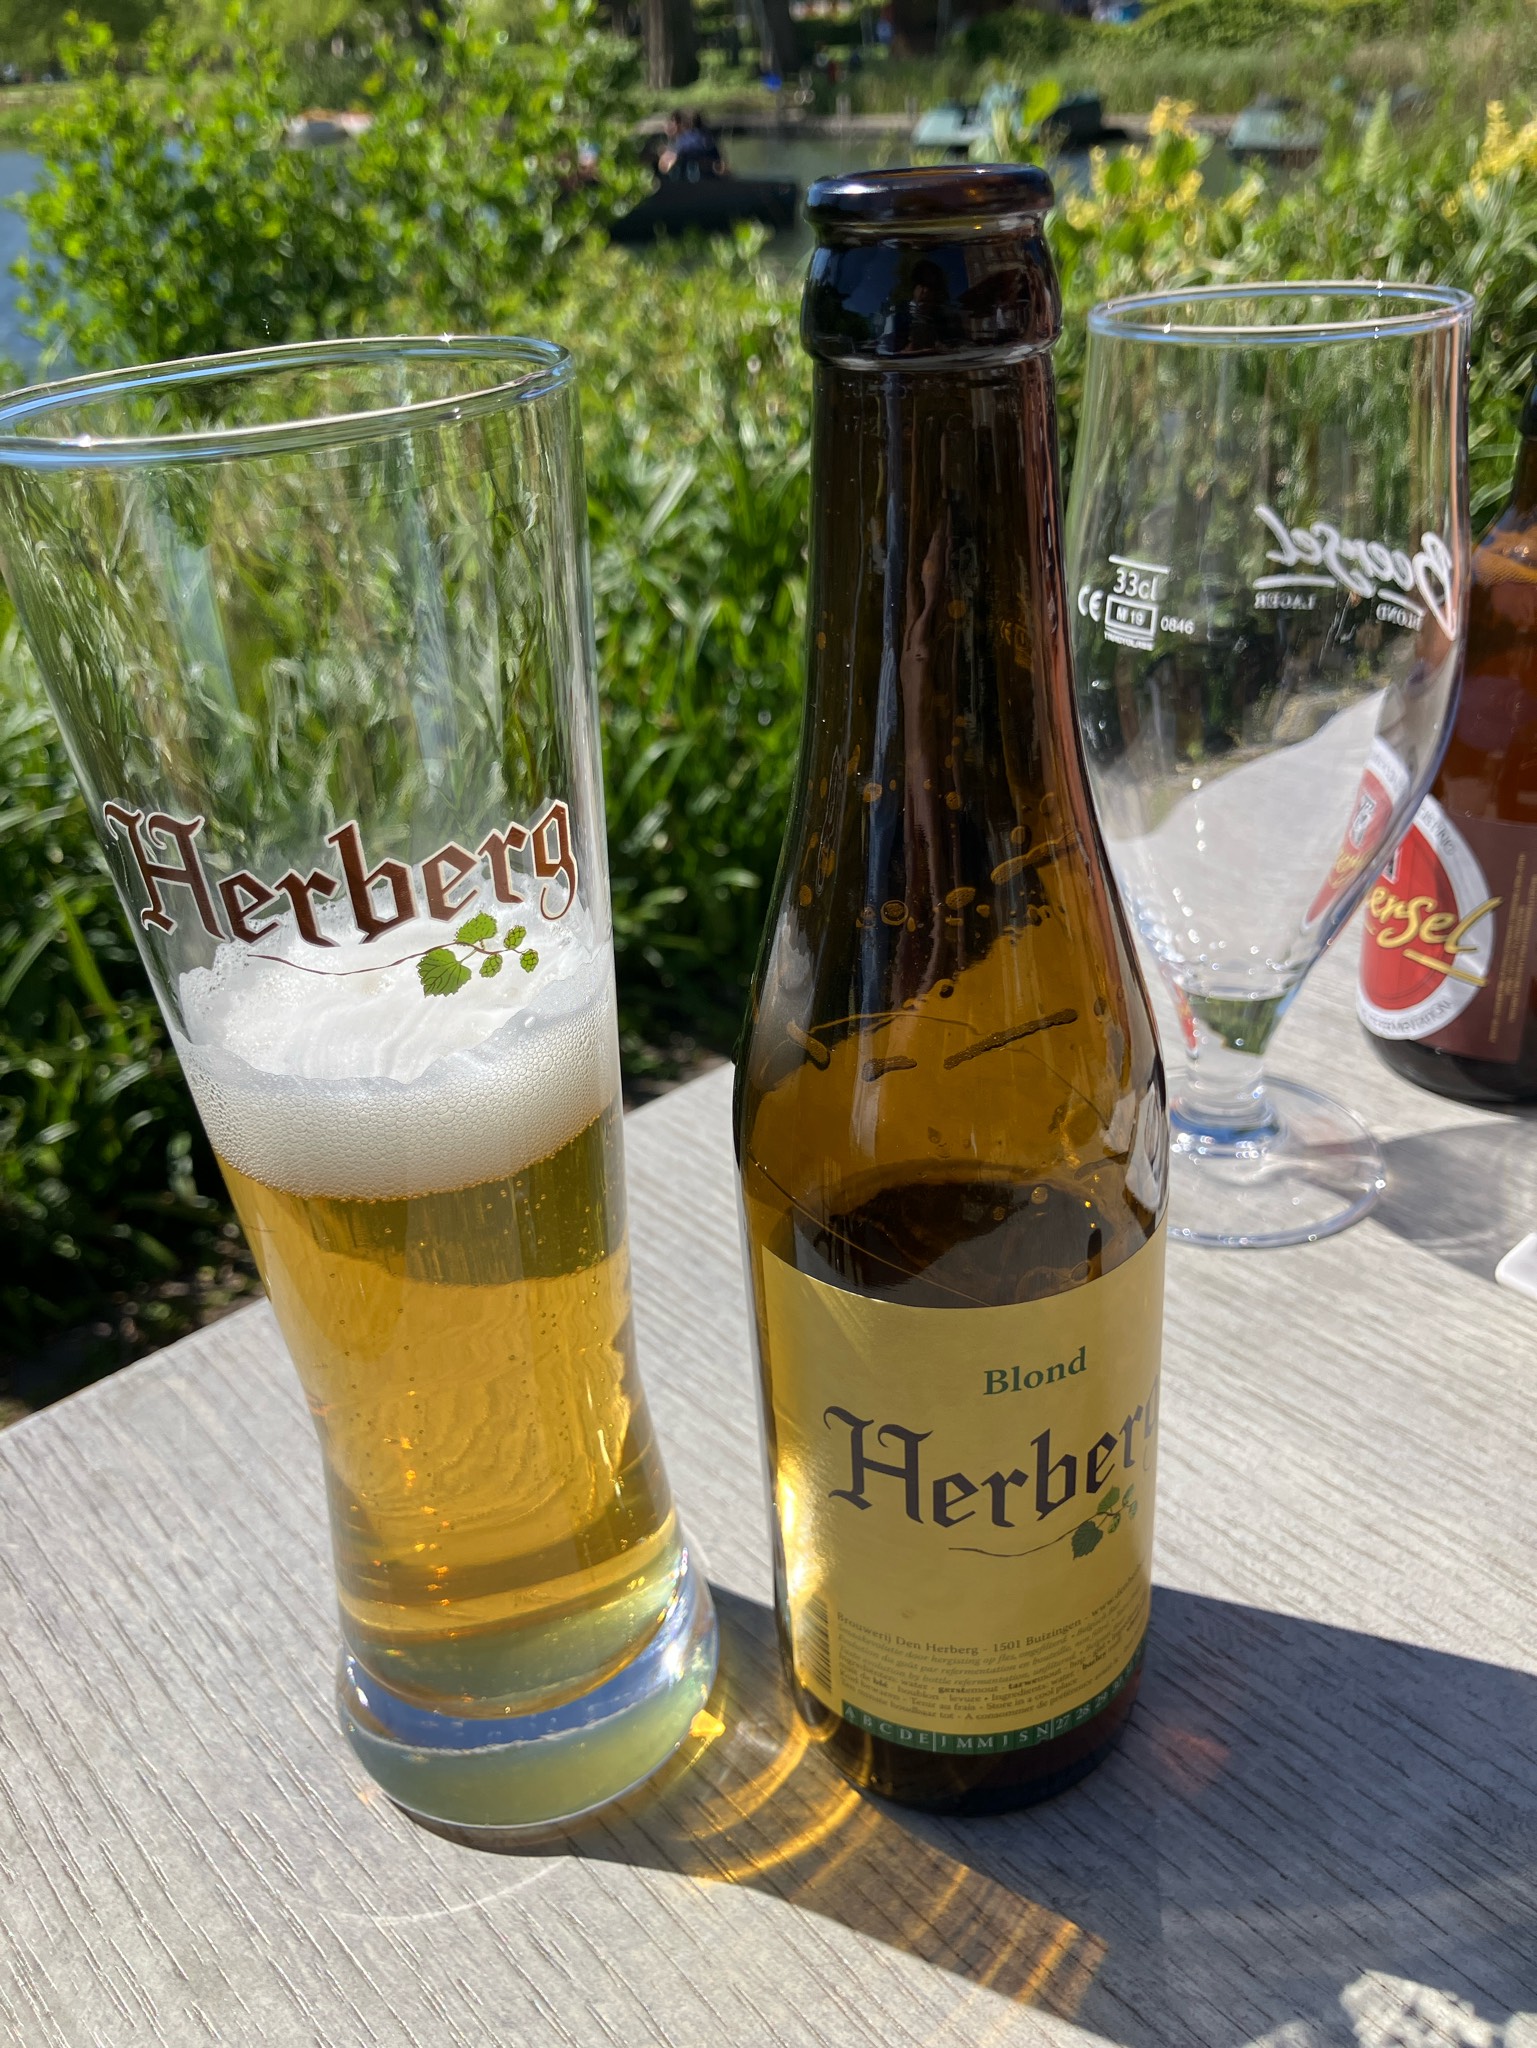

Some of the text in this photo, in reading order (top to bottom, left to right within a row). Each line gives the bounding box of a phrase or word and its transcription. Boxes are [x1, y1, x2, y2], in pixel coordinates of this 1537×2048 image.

[1112, 566, 1159, 600] 33cl
[1160, 615, 1196, 635] 0846
[103, 799, 578, 947] Herberg
[983, 1346, 1087, 1395] Blond
[837, 1611, 892, 1644] Brouwerij
[896, 1636, 921, 1650] Den
[926, 1642, 980, 1657] Herberg
[994, 1640, 1021, 1652] 1501
[1026, 1619, 1081, 1646] Buizingen
[941, 1664, 1017, 1676] refermentation
[1019, 1661, 1030, 1669] en
[983, 1657, 997, 1666] op
[898, 1685, 939, 1700] houblon
[949, 1694, 982, 1702] levure
[1051, 1672, 1075, 1685] water
[901, 1680, 928, 1690] water
[938, 1686, 998, 1694] gerstemout
[1008, 1668, 1062, 1689] tarwemout
[909, 1672, 920, 1681] by
[923, 1675, 951, 1684] bottle
[911, 1697, 936, 1708] Tenir
[954, 1703, 976, 1711] frais
[986, 1702, 1013, 1711] Store
[1034, 1687, 1055, 1700] cool
[940, 1712, 954, 1720] tot
[965, 1712, 974, 1720] A
[976, 1706, 1035, 1720] consommer
[1036, 1700, 1049, 1709] de
[844, 1704, 856, 1718] A
[862, 1714, 873, 1728] B
[879, 1722, 893, 1736] C
[900, 1728, 913, 1741] D
[919, 1732, 929, 1745] E
[956, 1737, 973, 1749] M
[977, 1736, 994, 1749] M
[1018, 1730, 1028, 1743] S
[1036, 1724, 1049, 1739] N
